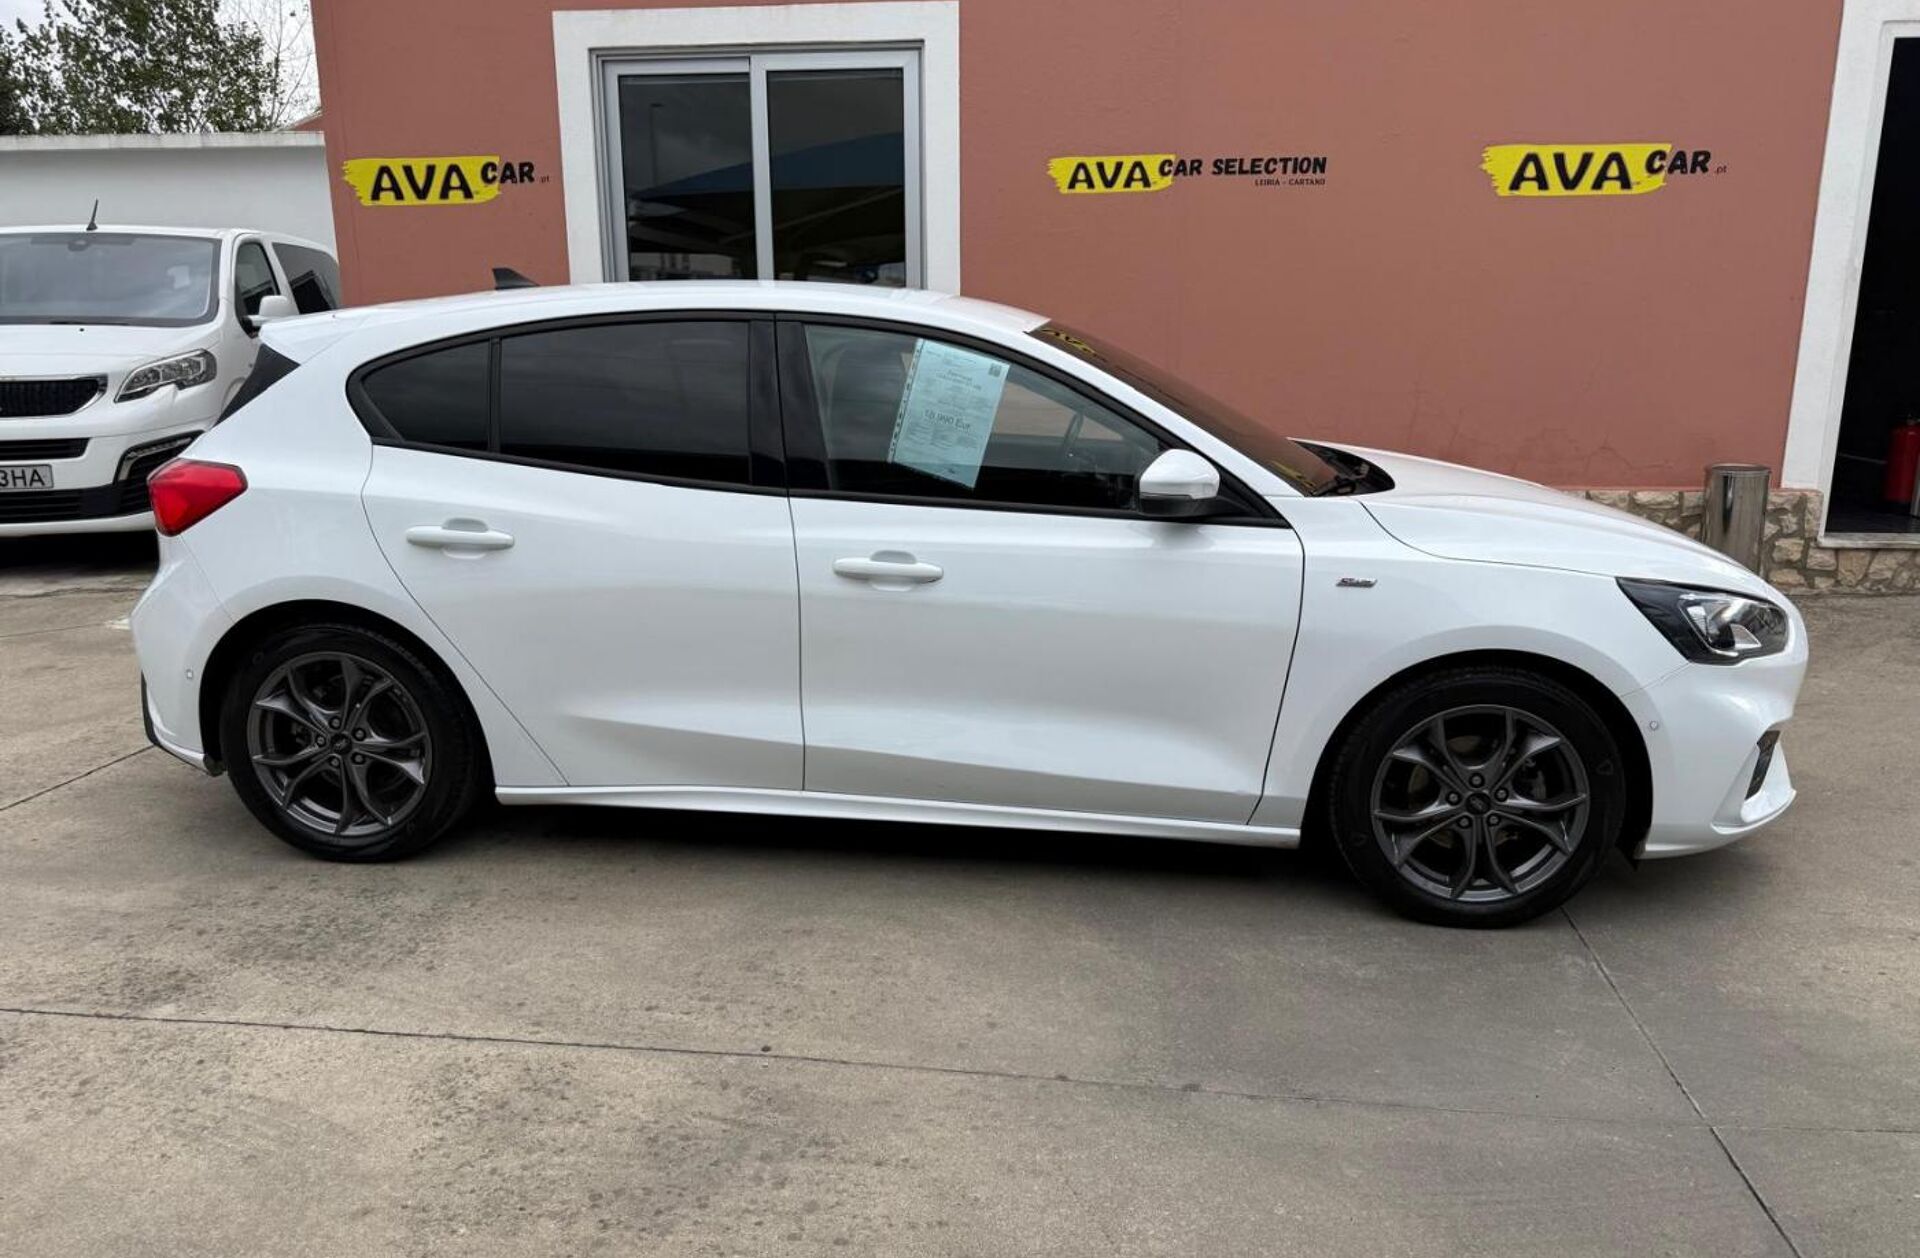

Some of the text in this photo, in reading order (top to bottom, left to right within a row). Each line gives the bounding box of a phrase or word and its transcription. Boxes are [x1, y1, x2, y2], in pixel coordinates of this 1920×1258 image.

[370, 164, 474, 201] AVA
[480, 161, 535, 184] CAR
[1067, 156, 1327, 190] AVA CAR SELECTION
[1509, 152, 1633, 191] AVA
[1645, 150, 1711, 174] CAR
